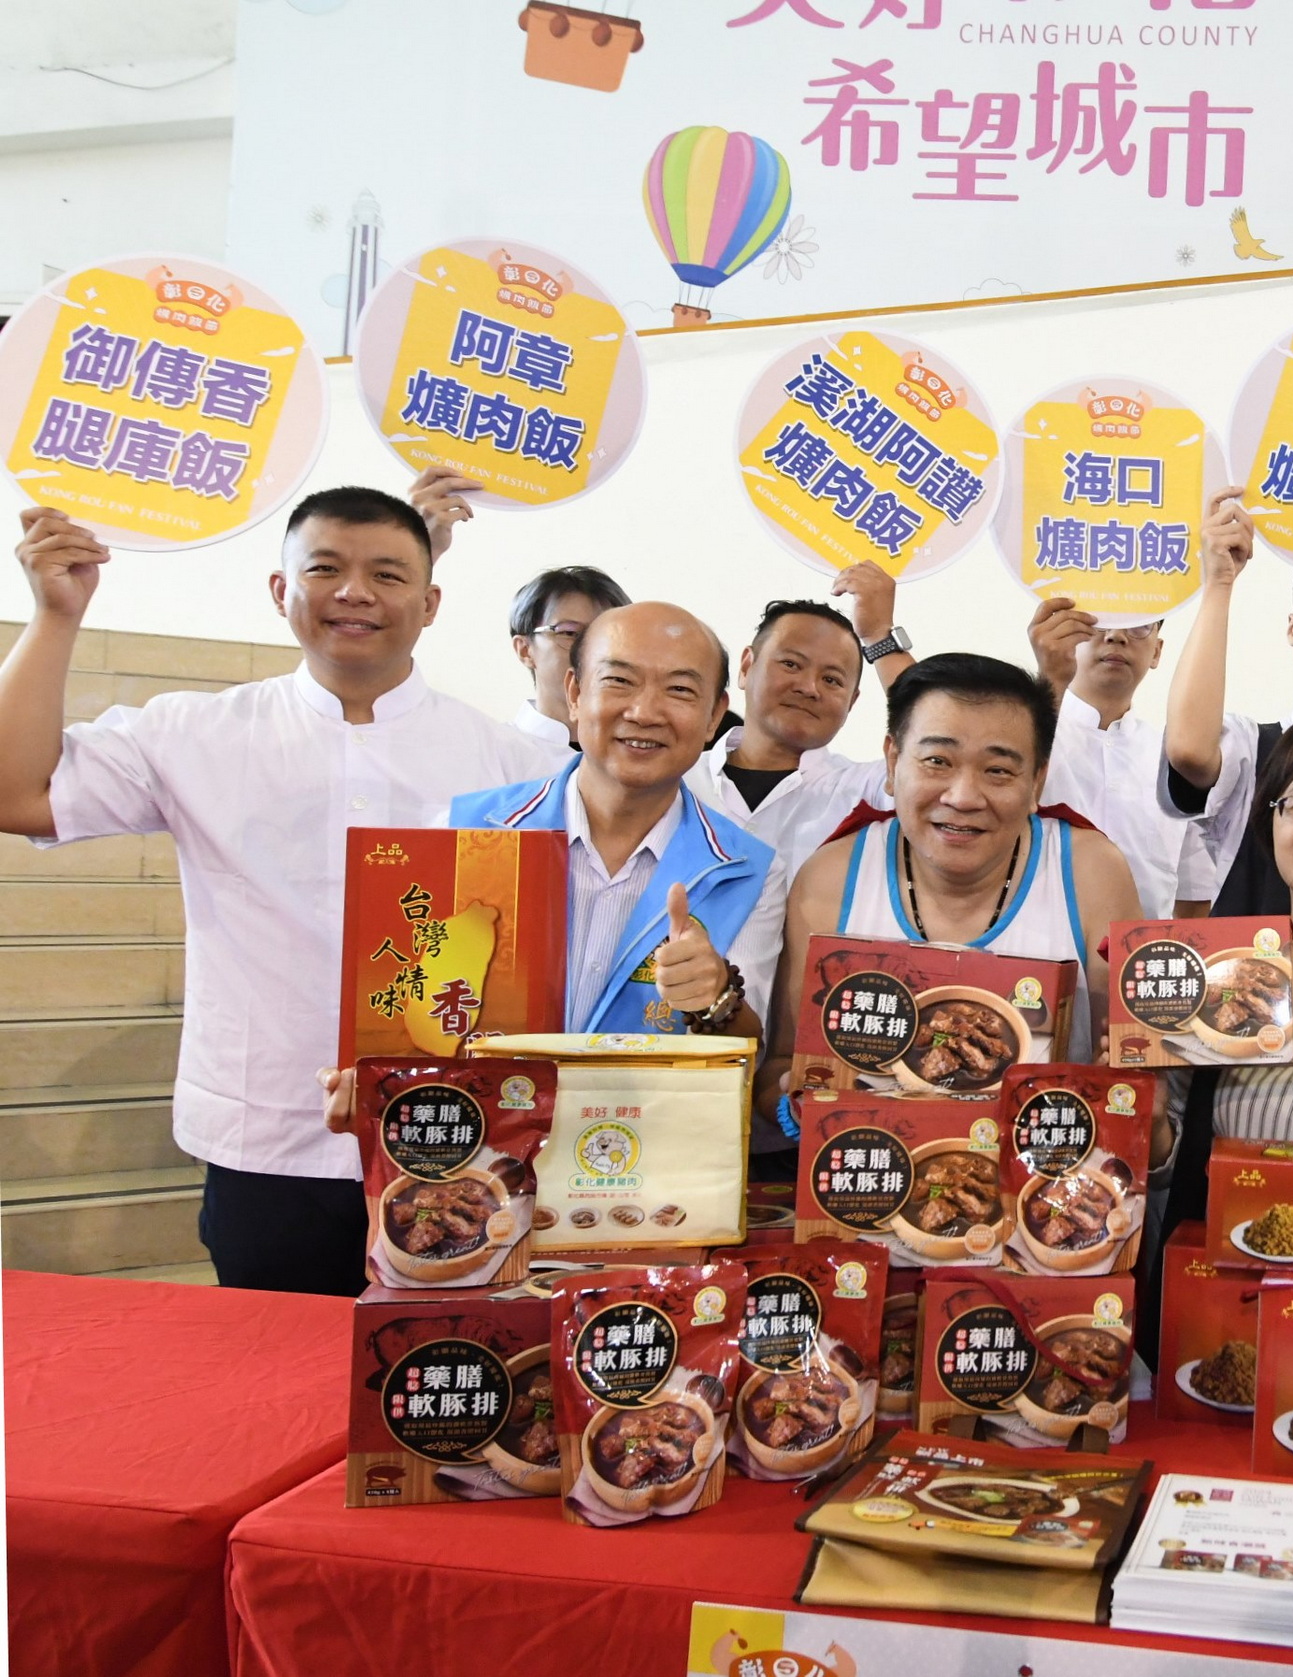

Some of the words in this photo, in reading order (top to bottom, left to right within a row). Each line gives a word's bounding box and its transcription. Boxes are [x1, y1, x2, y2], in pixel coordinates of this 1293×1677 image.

[960, 23, 1123, 45] CHANGHUA
[1138, 24, 1258, 46] COUNTY
[800, 58, 1254, 207] 希望城市
[449, 309, 573, 394] 阿章
[63, 324, 271, 425] 御傳香
[401, 368, 587, 472] 爌肉飯
[33, 398, 251, 502] 腿庫飯
[783, 353, 986, 524] 溪湖阿讚
[761, 420, 923, 557] 爌肉飯
[1062, 451, 1163, 505] 海口
[1034, 516, 1190, 575] 爌肉飯
[371, 842, 404, 857] 上品
[398, 882, 449, 959] 台灣
[369, 937, 429, 1020] 人情味
[1146, 958, 1187, 978] 藥膳
[1137, 978, 1199, 999] 軟豚排
[853, 990, 898, 1015] 藥膳
[839, 1012, 908, 1038] 軟豚排
[413, 1104, 462, 1123] 藥膳
[581, 1106, 608, 1119] 美好
[615, 1106, 643, 1119] 健康
[1040, 1107, 1077, 1126] 藥膳
[400, 1125, 475, 1144] 軟豚排
[1030, 1127, 1087, 1147] 軟豚排
[844, 1148, 892, 1170] 藥膳
[831, 1171, 904, 1193] 軟豚排
[1237, 1169, 1262, 1181] 上品
[758, 1293, 801, 1314] 藥膳
[606, 1323, 656, 1346] 藥膳
[968, 1326, 1016, 1349] 藥膳
[594, 1346, 668, 1372] 軟豚排
[955, 1350, 1029, 1375] 軟豚排
[422, 1364, 483, 1391] 藥膳
[408, 1391, 500, 1419] 軟豚排
